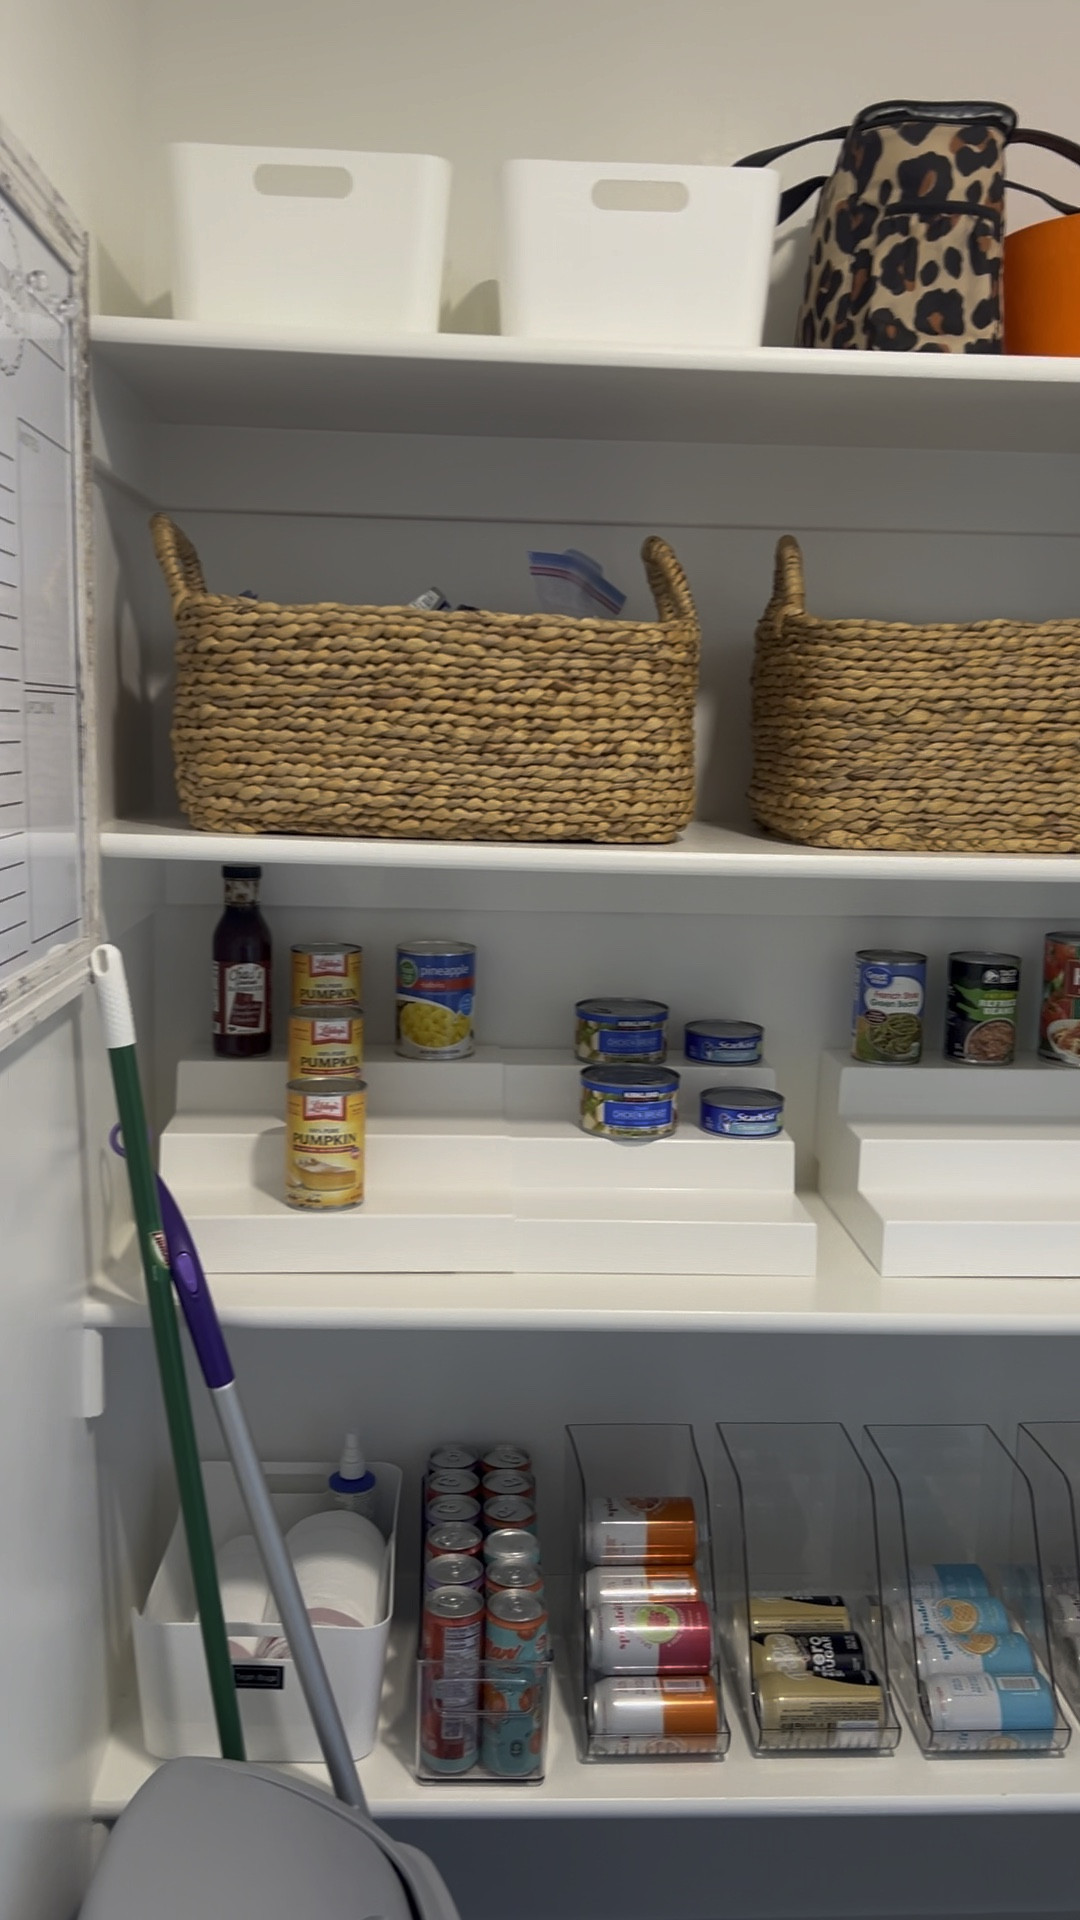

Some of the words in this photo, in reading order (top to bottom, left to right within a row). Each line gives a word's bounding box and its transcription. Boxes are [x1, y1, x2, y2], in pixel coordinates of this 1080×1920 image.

[420, 963, 470, 978] pineapple
[300, 988, 357, 999] PUMPKIN
[301, 1056, 359, 1067] PUMPKIN
[293, 1132, 357, 1145] PUMPKIN
